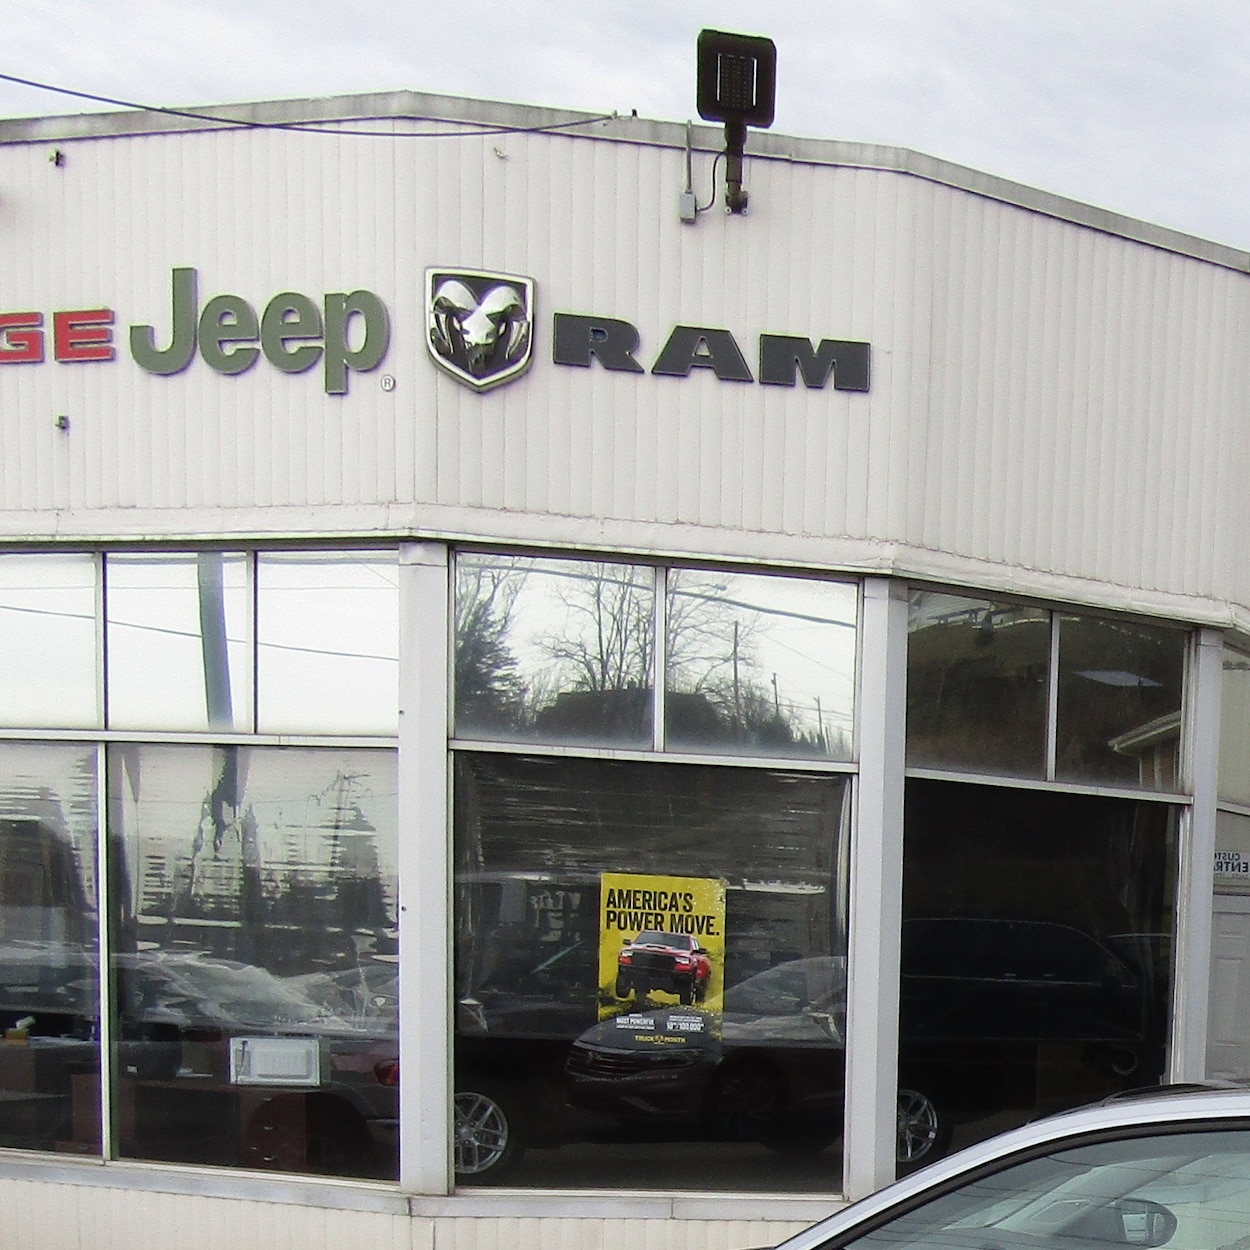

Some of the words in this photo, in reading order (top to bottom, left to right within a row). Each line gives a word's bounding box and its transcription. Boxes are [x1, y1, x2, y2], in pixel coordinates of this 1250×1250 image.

[129, 267, 390, 395] Jeep
[553, 312, 872, 393] RAM
[605, 910, 665, 932] POWER
[669, 914, 721, 936] MOVE.
[606, 888, 694, 913] AMERICA'S
